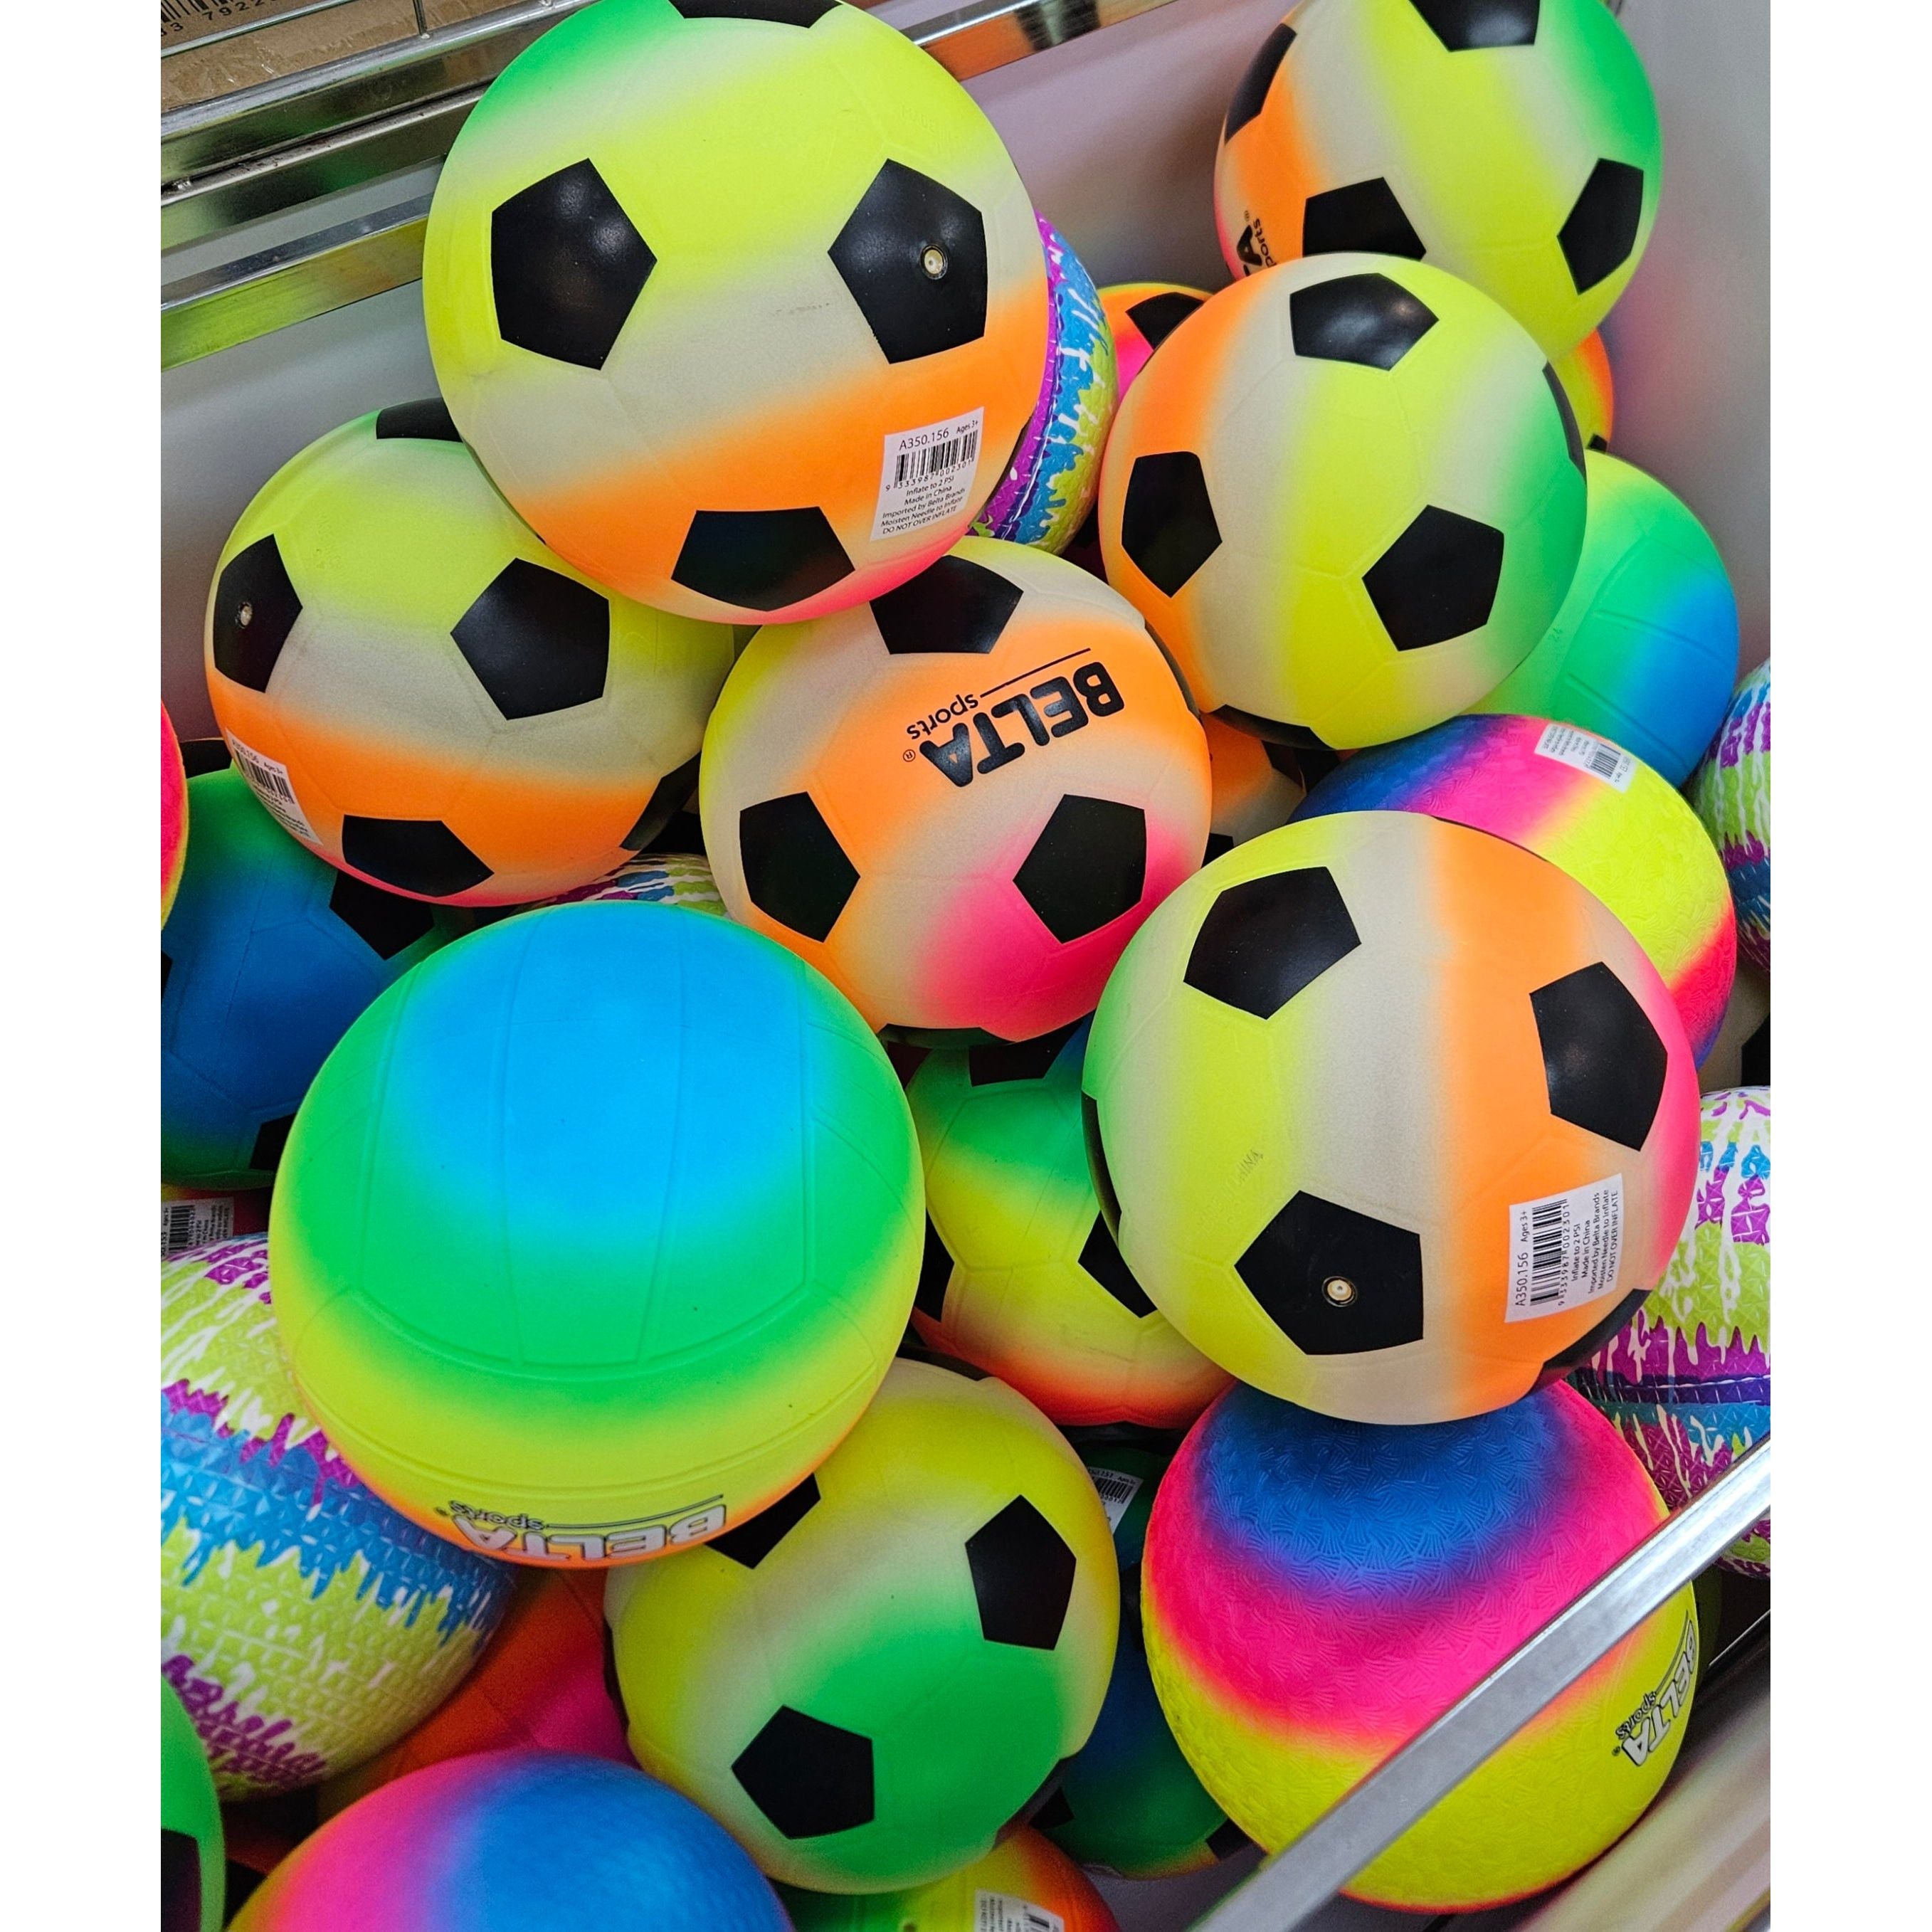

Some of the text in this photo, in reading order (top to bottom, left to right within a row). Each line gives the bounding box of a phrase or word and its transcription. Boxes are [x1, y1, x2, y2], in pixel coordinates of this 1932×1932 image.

[202, 0, 277, 21] 7922
[1253, 218, 1277, 268] ports
[899, 428, 949, 451] A350.156
[956, 423, 971, 435] Ages
[904, 495, 924, 505] Made
[934, 486, 952, 497] China
[906, 485, 929, 497] Inflate
[944, 475, 955, 485] PSI
[881, 516, 910, 527] Moisten
[911, 508, 935, 519] Needle
[882, 505, 917, 519] Imported
[927, 497, 944, 507] Belta
[882, 505, 957, 534] DO NOT OVER INFLATE
[907, 694, 979, 740] sports
[919, 661, 1125, 788] BELTA
[1562, 1204, 1571, 1249] 002301
[1515, 1211, 1530, 1307] A350.156 Ages 3+
[1574, 1246, 1580, 1255] to
[1583, 1246, 1589, 1255] in
[1592, 1247, 1600, 1258] by
[1597, 1259, 1608, 1289] Moisten
[1603, 1219, 1609, 1228] to
[1571, 1257, 1580, 1282] Inflate
[1588, 1258, 1599, 1294] Imported
[1606, 1269, 1614, 1282] DO
[448, 1499, 546, 1531] sports
[452, 1504, 727, 1561] BELTA
[1621, 1620, 1696, 1767] BELTA
[1615, 1691, 1657, 1741] sports
